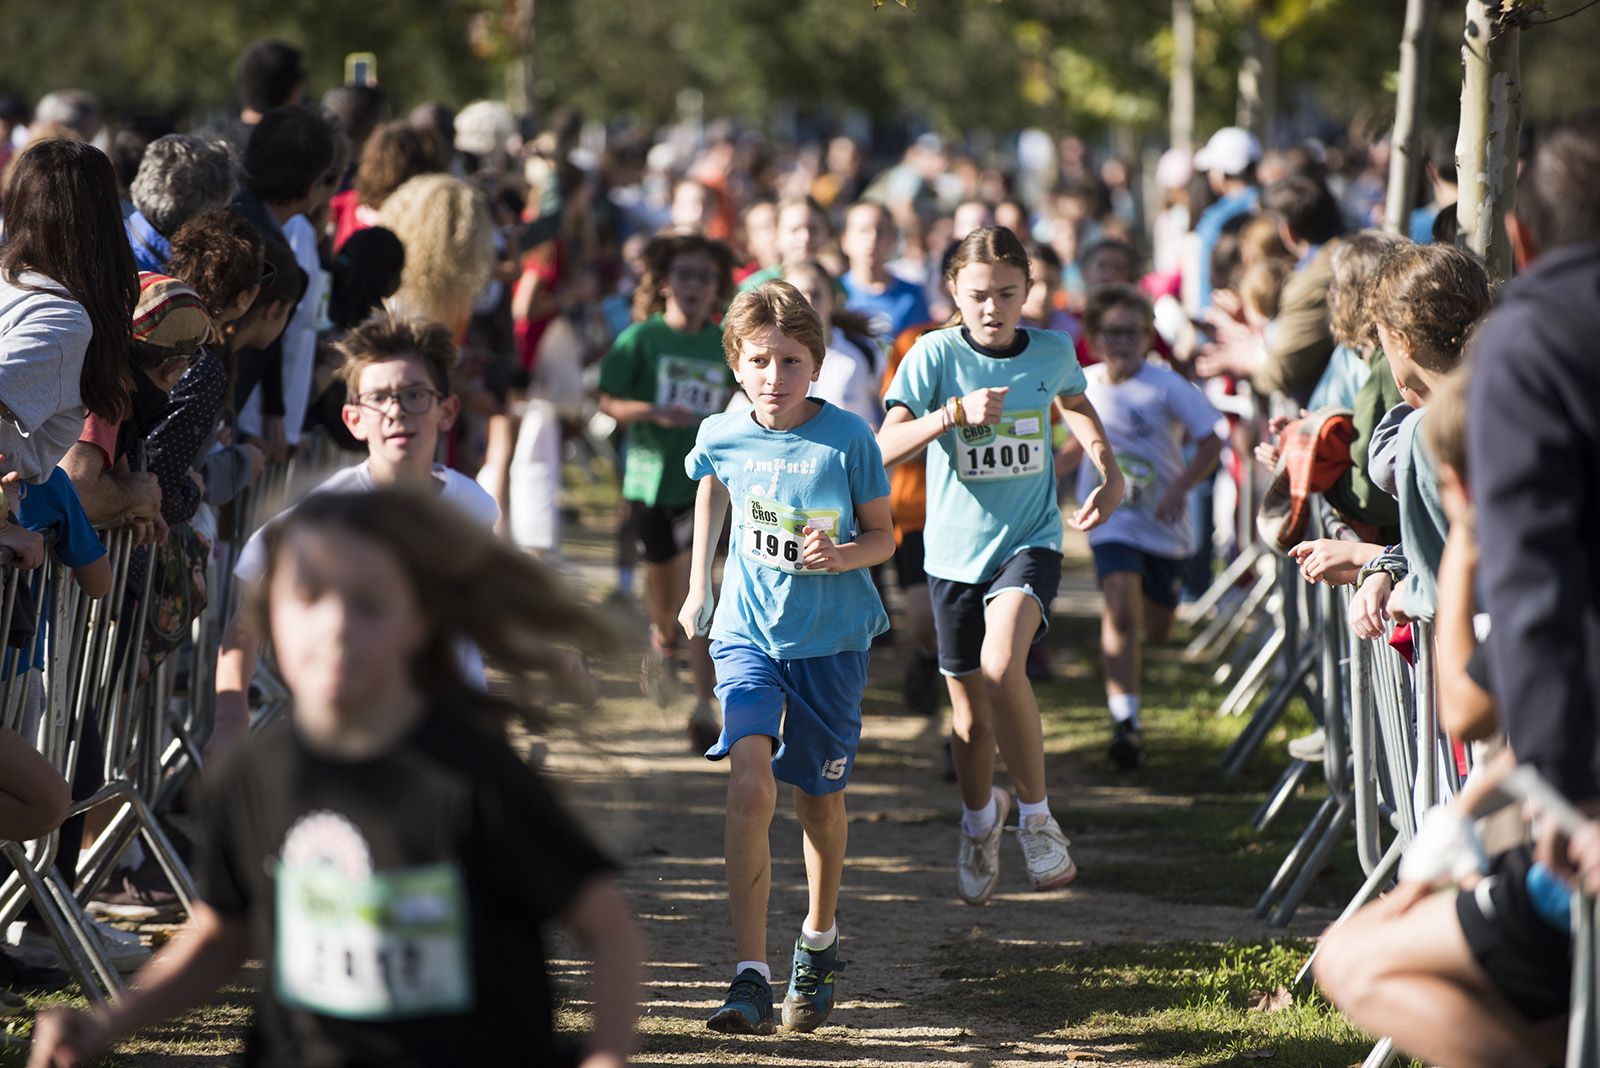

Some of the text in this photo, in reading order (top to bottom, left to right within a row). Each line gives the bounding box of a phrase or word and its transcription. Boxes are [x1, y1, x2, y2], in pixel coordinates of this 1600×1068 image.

[963, 424, 992, 439] CROS
[967, 443, 1030, 470] 1400
[752, 508, 778, 523] CROS
